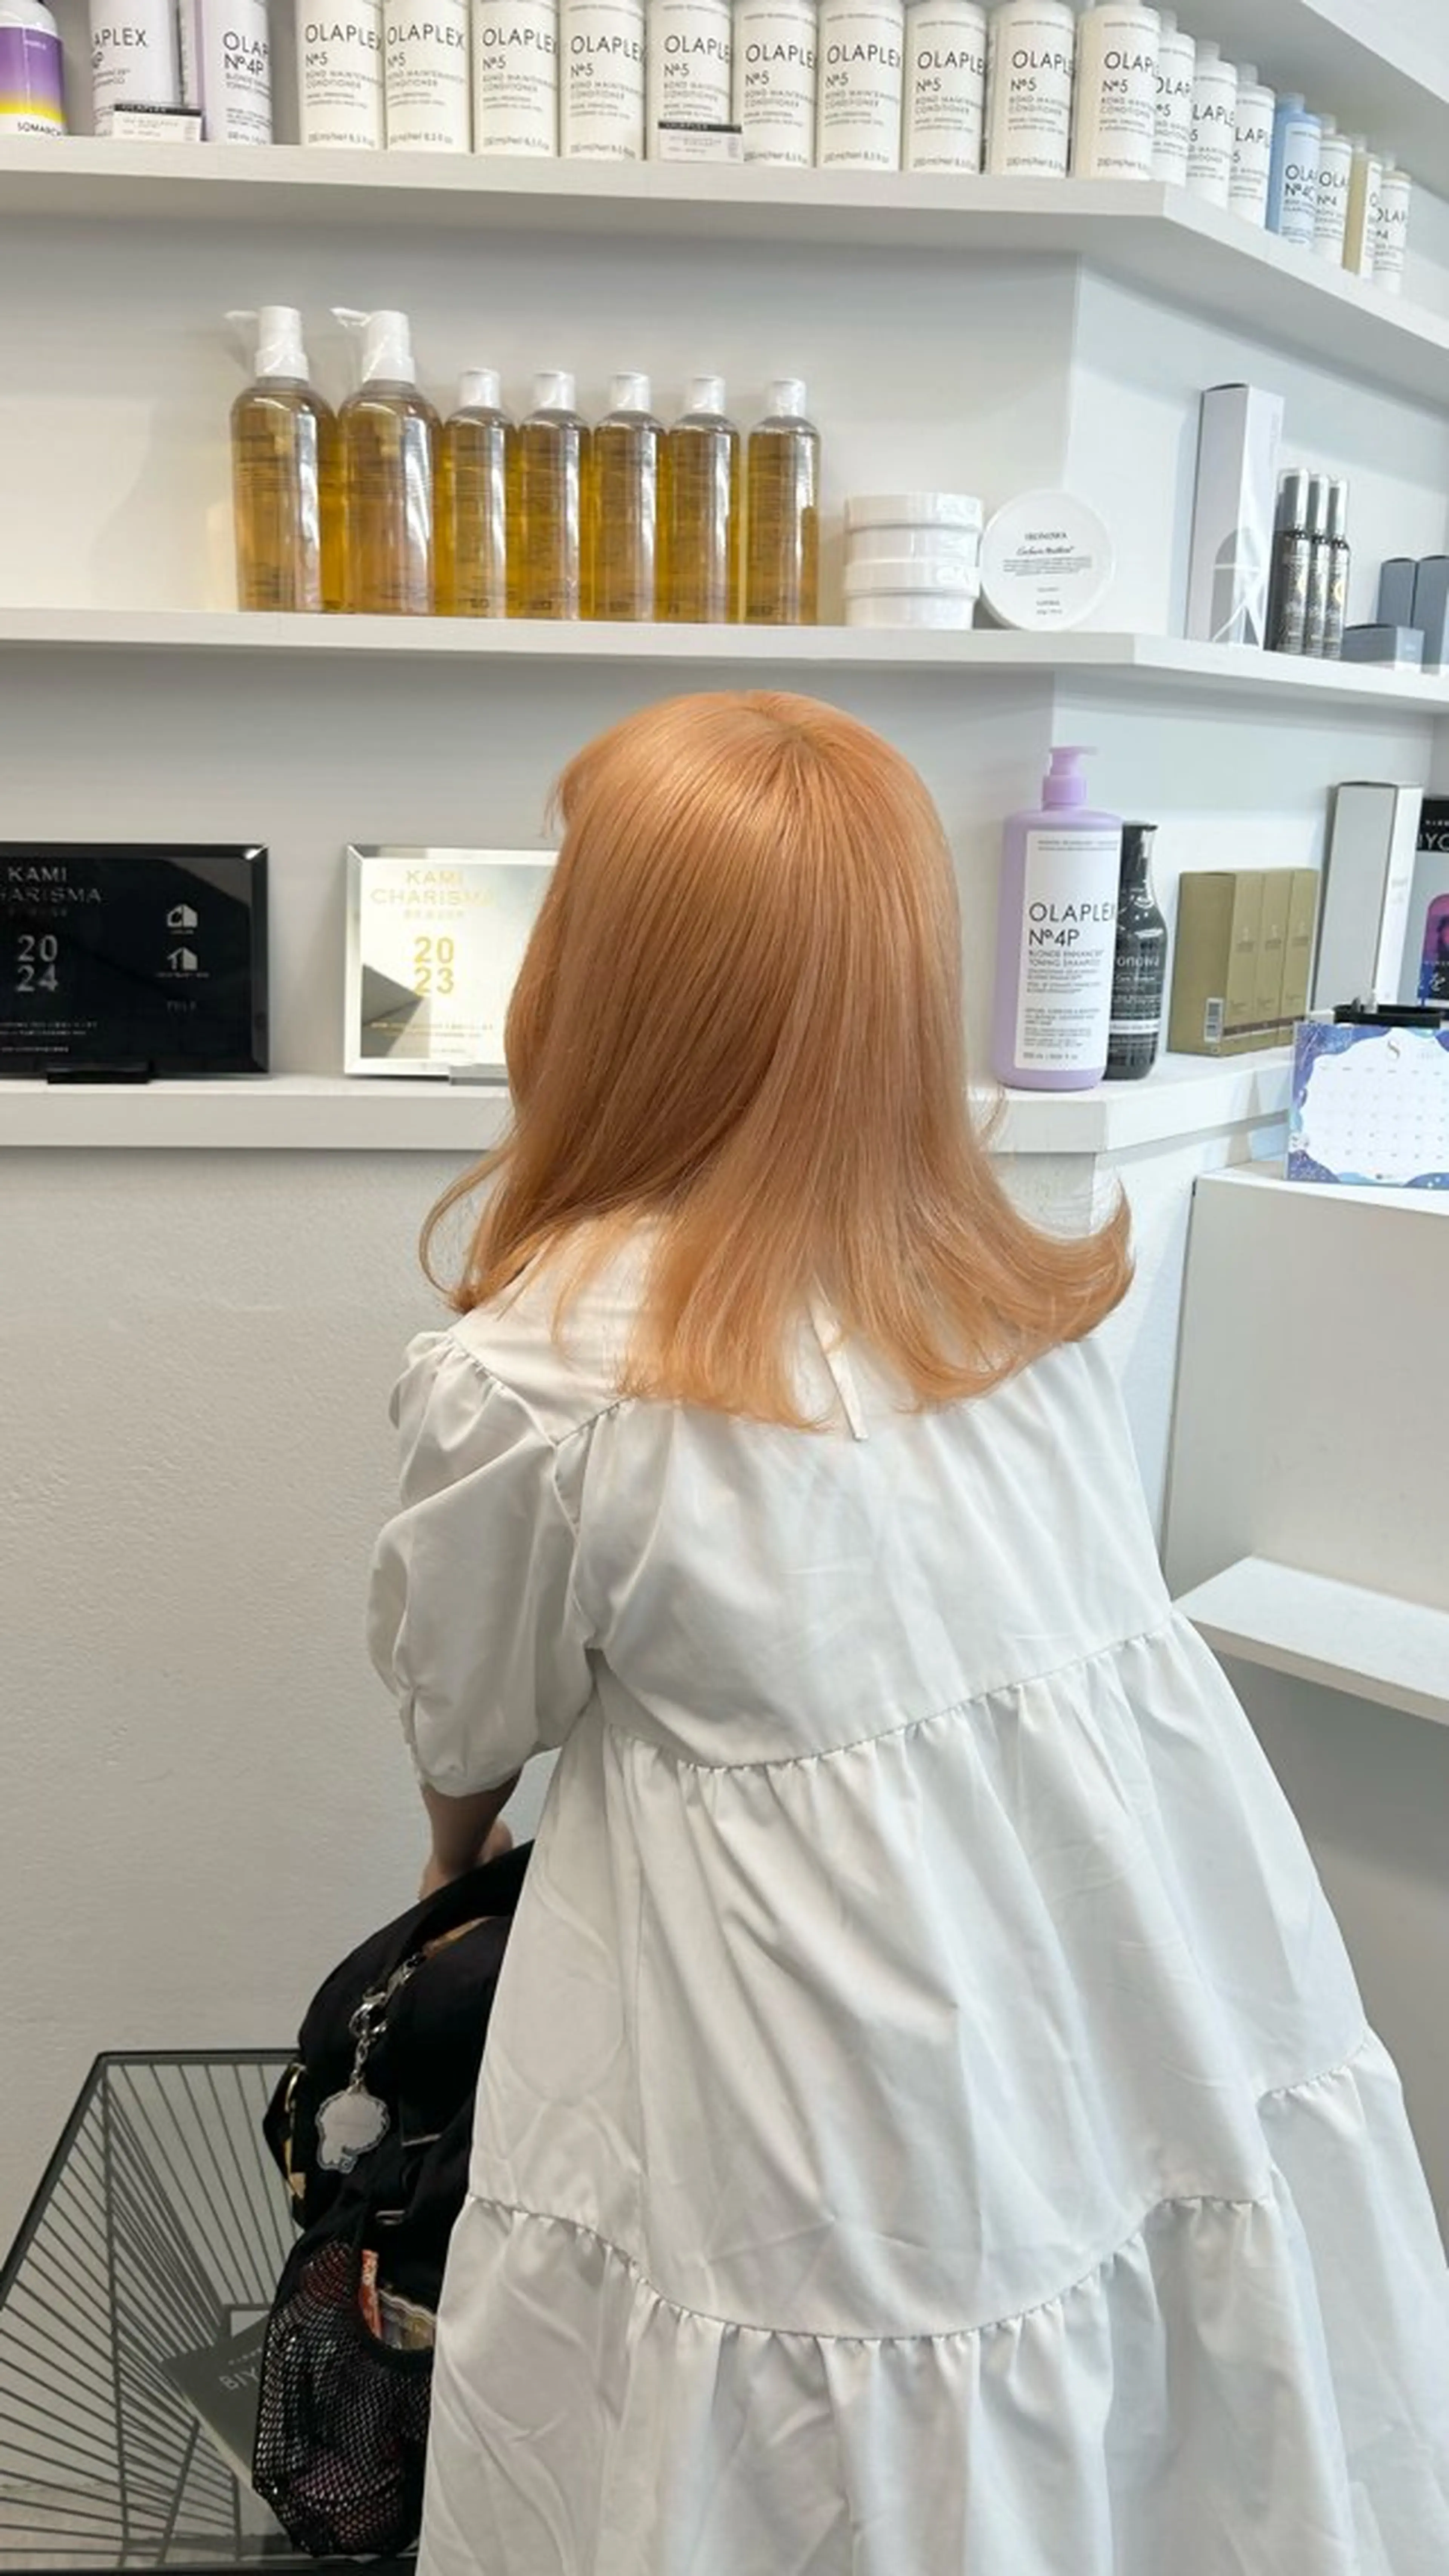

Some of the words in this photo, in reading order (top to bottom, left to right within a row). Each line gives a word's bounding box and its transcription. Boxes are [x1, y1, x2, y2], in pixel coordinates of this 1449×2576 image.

[8, 867, 68, 882] KAMI
[406, 869, 463, 885] KAMI
[18, 934, 58, 962] 20
[414, 936, 455, 964] 20
[16, 964, 58, 992] 24
[414, 967, 455, 997] 23
[218, 2365, 260, 2391] BIY
